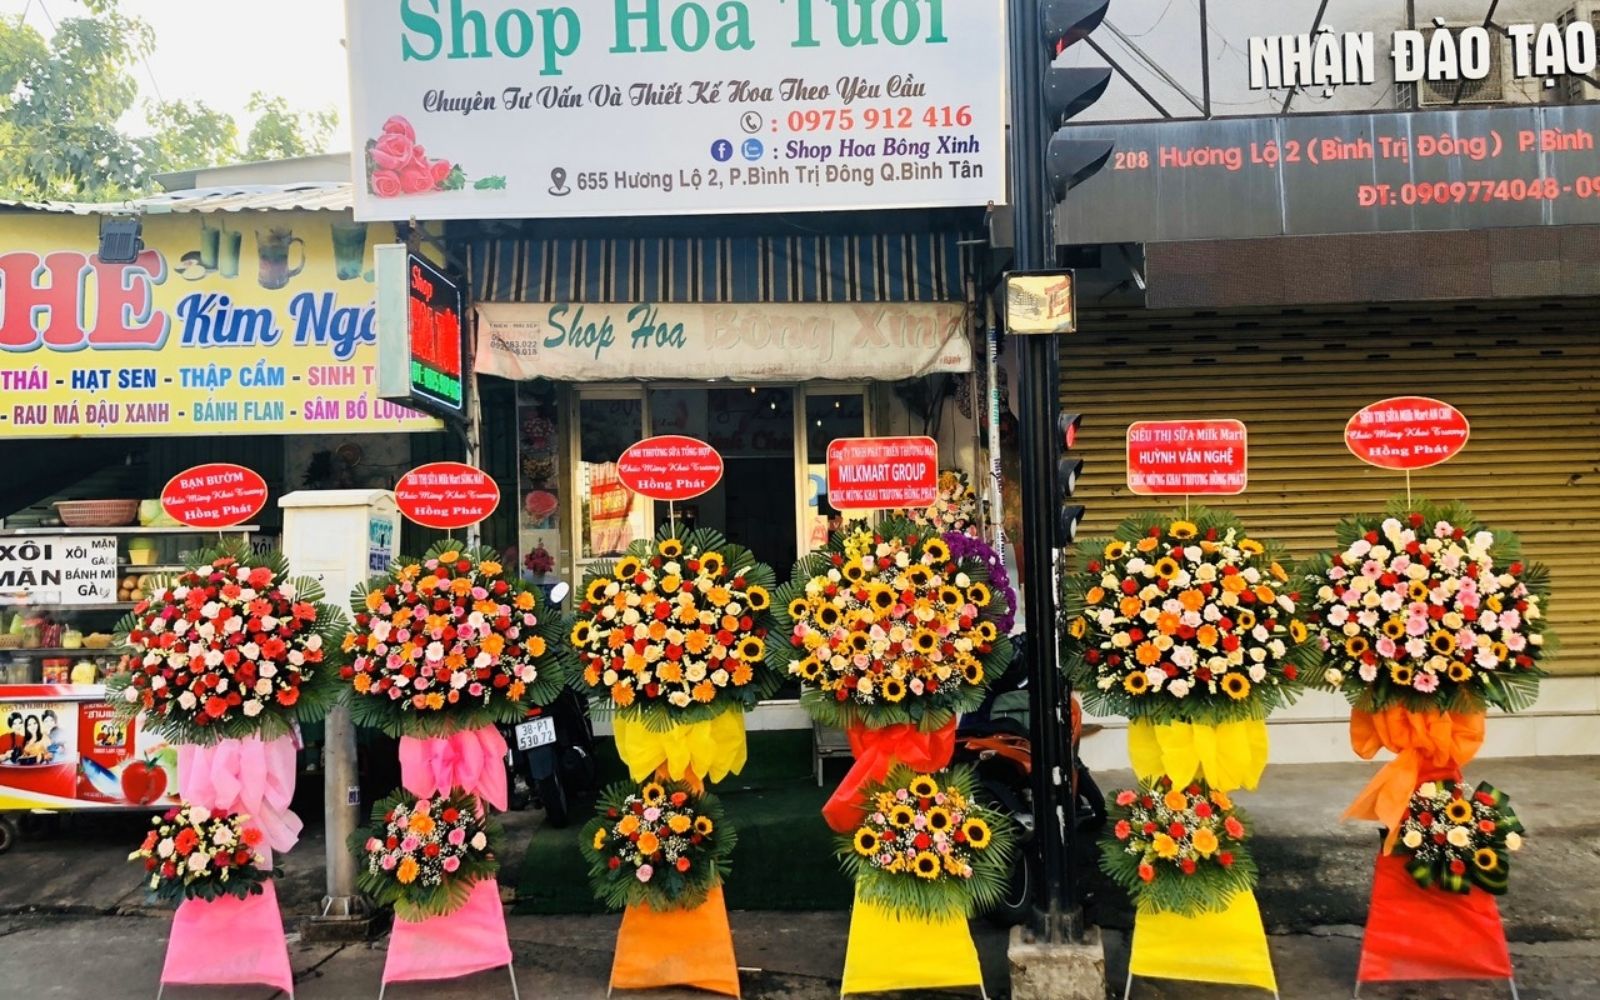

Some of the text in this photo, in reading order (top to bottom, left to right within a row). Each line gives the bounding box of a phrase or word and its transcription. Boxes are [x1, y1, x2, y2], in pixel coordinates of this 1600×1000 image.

[400, 0, 581, 75] Shop
[609, 0, 755, 52] Hoa
[1249, 17, 1596, 97] NHẬN ĐÀO TẠO
[423, 73, 926, 115] Chuyên Tư Vấn Và Thiết Kế Hoa Theo Yêu Cầu
[788, 105, 972, 132] 0975 912 416
[785, 135, 980, 162] Shop Hoa Bông Xinh
[1114, 150, 1149, 170] 208
[1159, 146, 1242, 171] Hương
[1250, 140, 1279, 169] Lộ
[1285, 141, 1300, 162] 2
[1378, 136, 1408, 163] Trị
[577, 159, 984, 193] 655 Hương Lộ 2, P.Bình Trị Đông Q.Bình Tân
[411, 264, 434, 302] Shop
[177, 292, 280, 345] Kim
[543, 303, 615, 360] Shop
[627, 303, 687, 349] Hoa
[702, 306, 835, 362] Bông
[852, 306, 962, 349] Xinh
[1, 358, 377, 393] THÁI HẠT SEN THẬP CẨM SINH T
[13, 404, 47, 425] RAU
[53, 400, 80, 424] MÁ
[85, 399, 119, 428] ĐẬU
[125, 403, 169, 424] XANH
[193, 398, 238, 422] BÁNH
[244, 401, 284, 421] FLAN
[304, 396, 339, 420] SÂM
[345, 392, 370, 420] BỔ
[1130, 425, 1244, 443] SIÊU THỊ SỮA Milk Mart
[1139, 446, 1234, 466] HUỲNH VĂN NGHỆ
[1368, 444, 1449, 457] Hồng Phát
[839, 462, 926, 482] MILKMART GROUP
[180, 477, 204, 490] BẠN
[638, 477, 706, 490] Hồng Phát
[184, 503, 252, 520] Hồng Phát
[414, 505, 483, 517] Hồng Phát
[0, 540, 52, 561] XÔI
[65, 546, 87, 559] XÔI
[91, 538, 116, 550] MẶN
[0, 567, 61, 591] MẶN
[65, 567, 116, 580] BÁNH MÌ
[78, 582, 98, 596] GÀ
